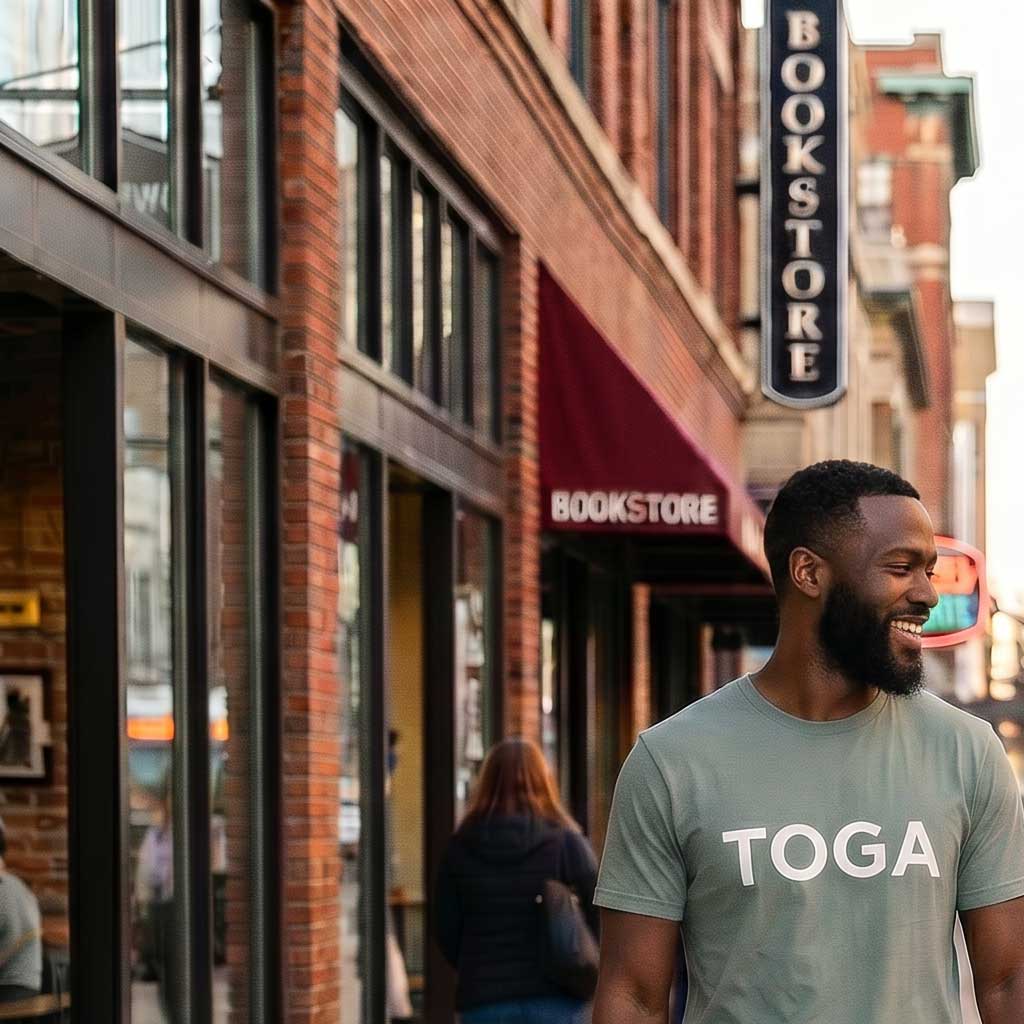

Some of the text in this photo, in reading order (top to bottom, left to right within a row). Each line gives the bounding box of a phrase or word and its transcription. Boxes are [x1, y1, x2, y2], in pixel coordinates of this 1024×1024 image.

[780, 9, 826, 382] BOOKSTORE
[551, 491, 718, 525] BOOKSTORE
[721, 820, 941, 887] TOGA
